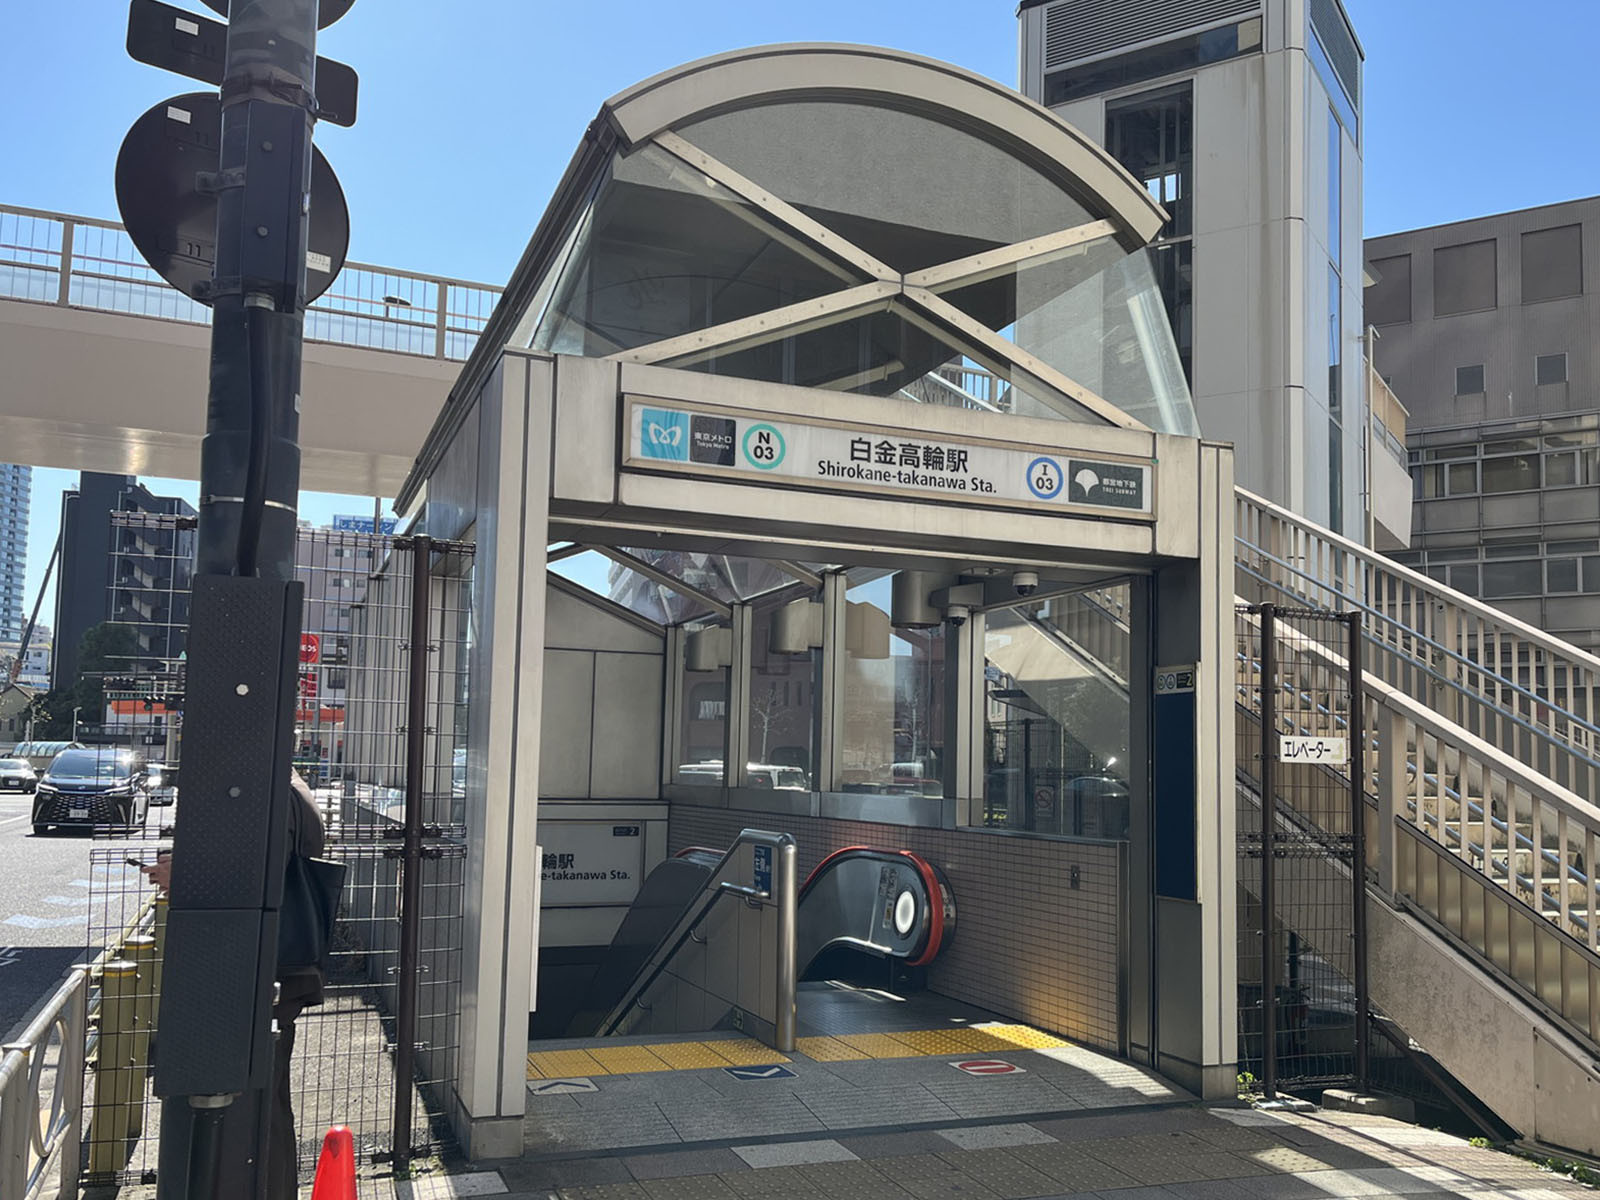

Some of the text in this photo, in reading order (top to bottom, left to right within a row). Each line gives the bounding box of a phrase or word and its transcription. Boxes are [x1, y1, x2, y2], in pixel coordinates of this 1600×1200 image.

[758, 431, 770, 444] N
[753, 445, 774, 460] 03
[850, 437, 968, 473] 白金高輪駅
[818, 460, 997, 493] Shirokane-takanawa Sta.
[1042, 464, 1048, 476] I
[1036, 477, 1053, 490] 03
[1284, 741, 1331, 759] エレベーター
[610, 870, 631, 881] Sta.
